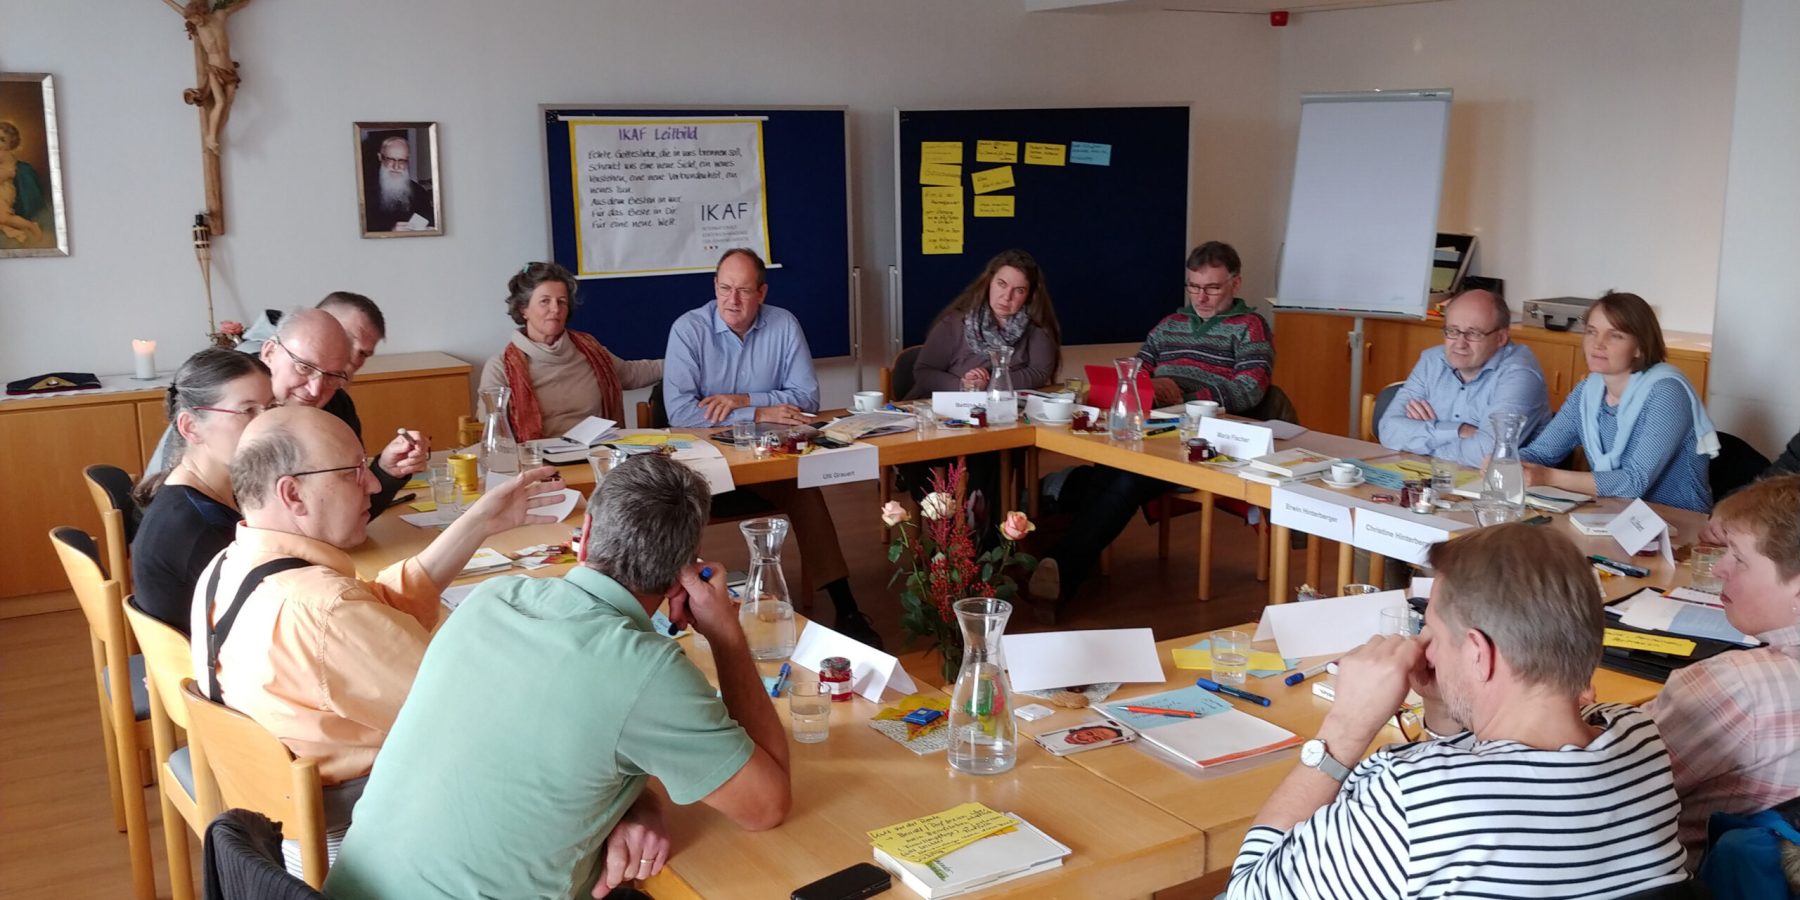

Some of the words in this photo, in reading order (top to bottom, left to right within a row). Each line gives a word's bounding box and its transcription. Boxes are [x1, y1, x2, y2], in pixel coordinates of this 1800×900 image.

[618, 127, 647, 141] IKAF
[655, 126, 698, 140] Leitbild
[701, 202, 748, 221] IKAF
